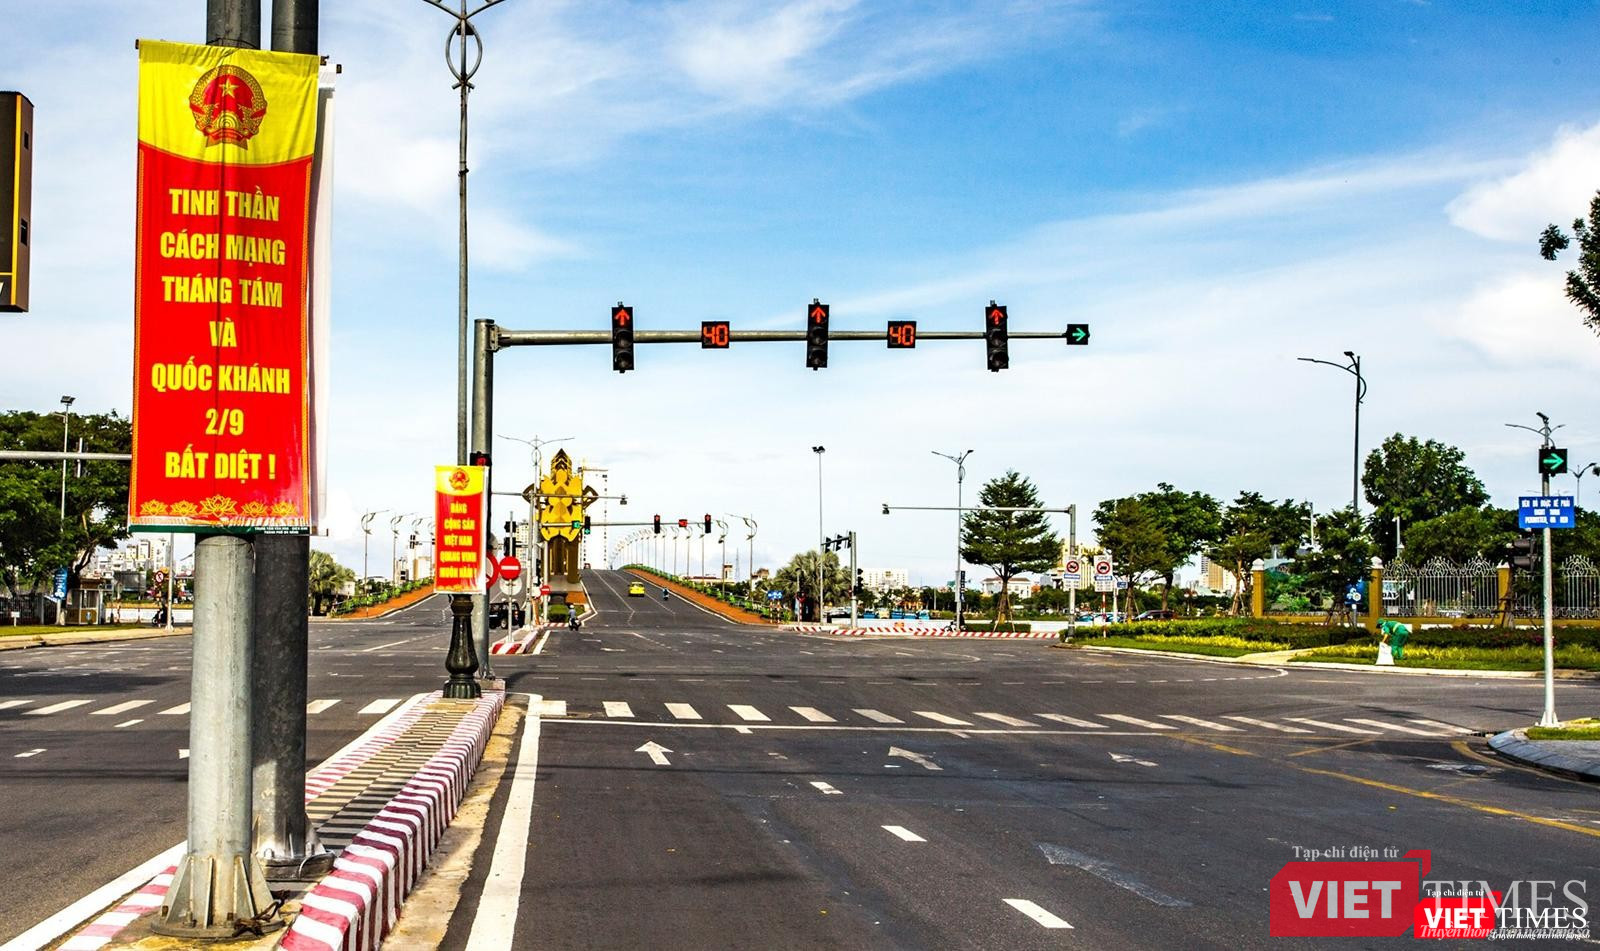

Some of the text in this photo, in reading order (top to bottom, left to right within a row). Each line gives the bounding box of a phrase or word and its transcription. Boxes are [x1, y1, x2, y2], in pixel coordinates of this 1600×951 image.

[168, 185, 280, 222] TINH THẦN
[160, 228, 286, 267] CÁCH MẠNG
[161, 272, 283, 308] THÁNG TÁM
[209, 317, 237, 347] VÀ
[703, 324, 728, 346] 40
[889, 324, 914, 346] 40
[151, 355, 290, 394] QUỐC KHÁNH
[205, 408, 244, 436] 2/9
[165, 444, 208, 479] BẤT
[215, 449, 262, 484] DIỆT
